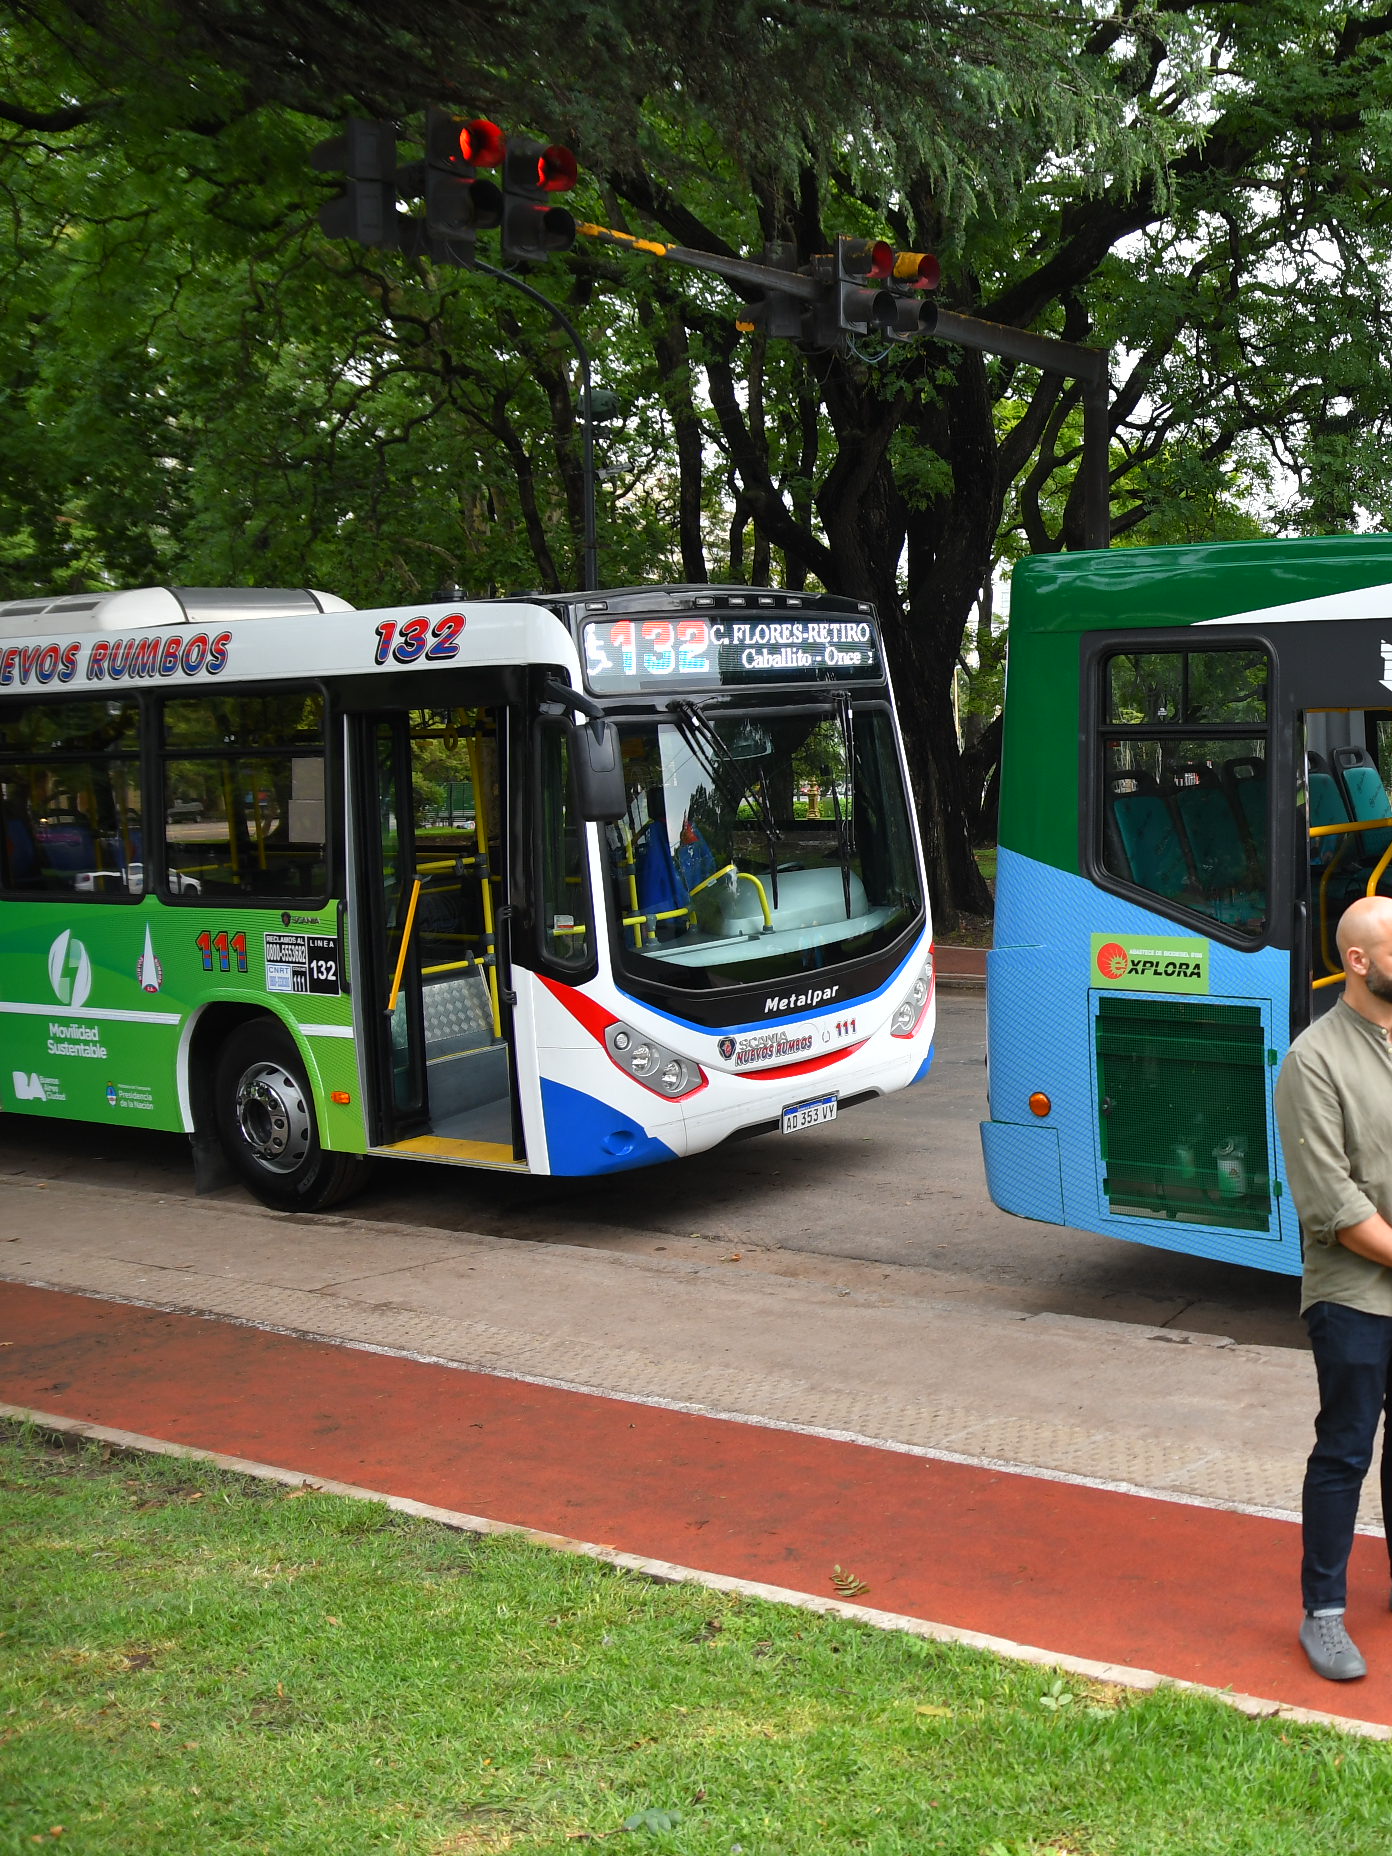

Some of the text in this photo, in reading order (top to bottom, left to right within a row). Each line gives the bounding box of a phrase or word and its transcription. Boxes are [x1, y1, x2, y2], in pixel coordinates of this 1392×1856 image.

[374, 612, 467, 666] 132
[710, 622, 871, 645] C. FLORES-RETIRO
[0, 631, 233, 686] EVOS RUMBOS
[610, 619, 710, 676] 132
[741, 647, 813, 669] Caballito
[824, 646, 862, 666] Once
[195, 930, 248, 973] 111
[309, 939, 335, 948] LINEA
[268, 966, 290, 974] CNRT
[310, 959, 337, 981] 132
[293, 974, 306, 992] 111
[764, 984, 840, 1013] Metalpar
[49, 1022, 99, 1041] Movilidad
[835, 1017, 857, 1037] 111
[47, 1039, 108, 1059] Sustentable
[734, 1034, 813, 1067] NUEVOS RUMBOS
[739, 1030, 789, 1051] SCANIA
[786, 1114, 798, 1131] AD
[801, 1108, 819, 1126] 353
[822, 1103, 835, 1120] VY
